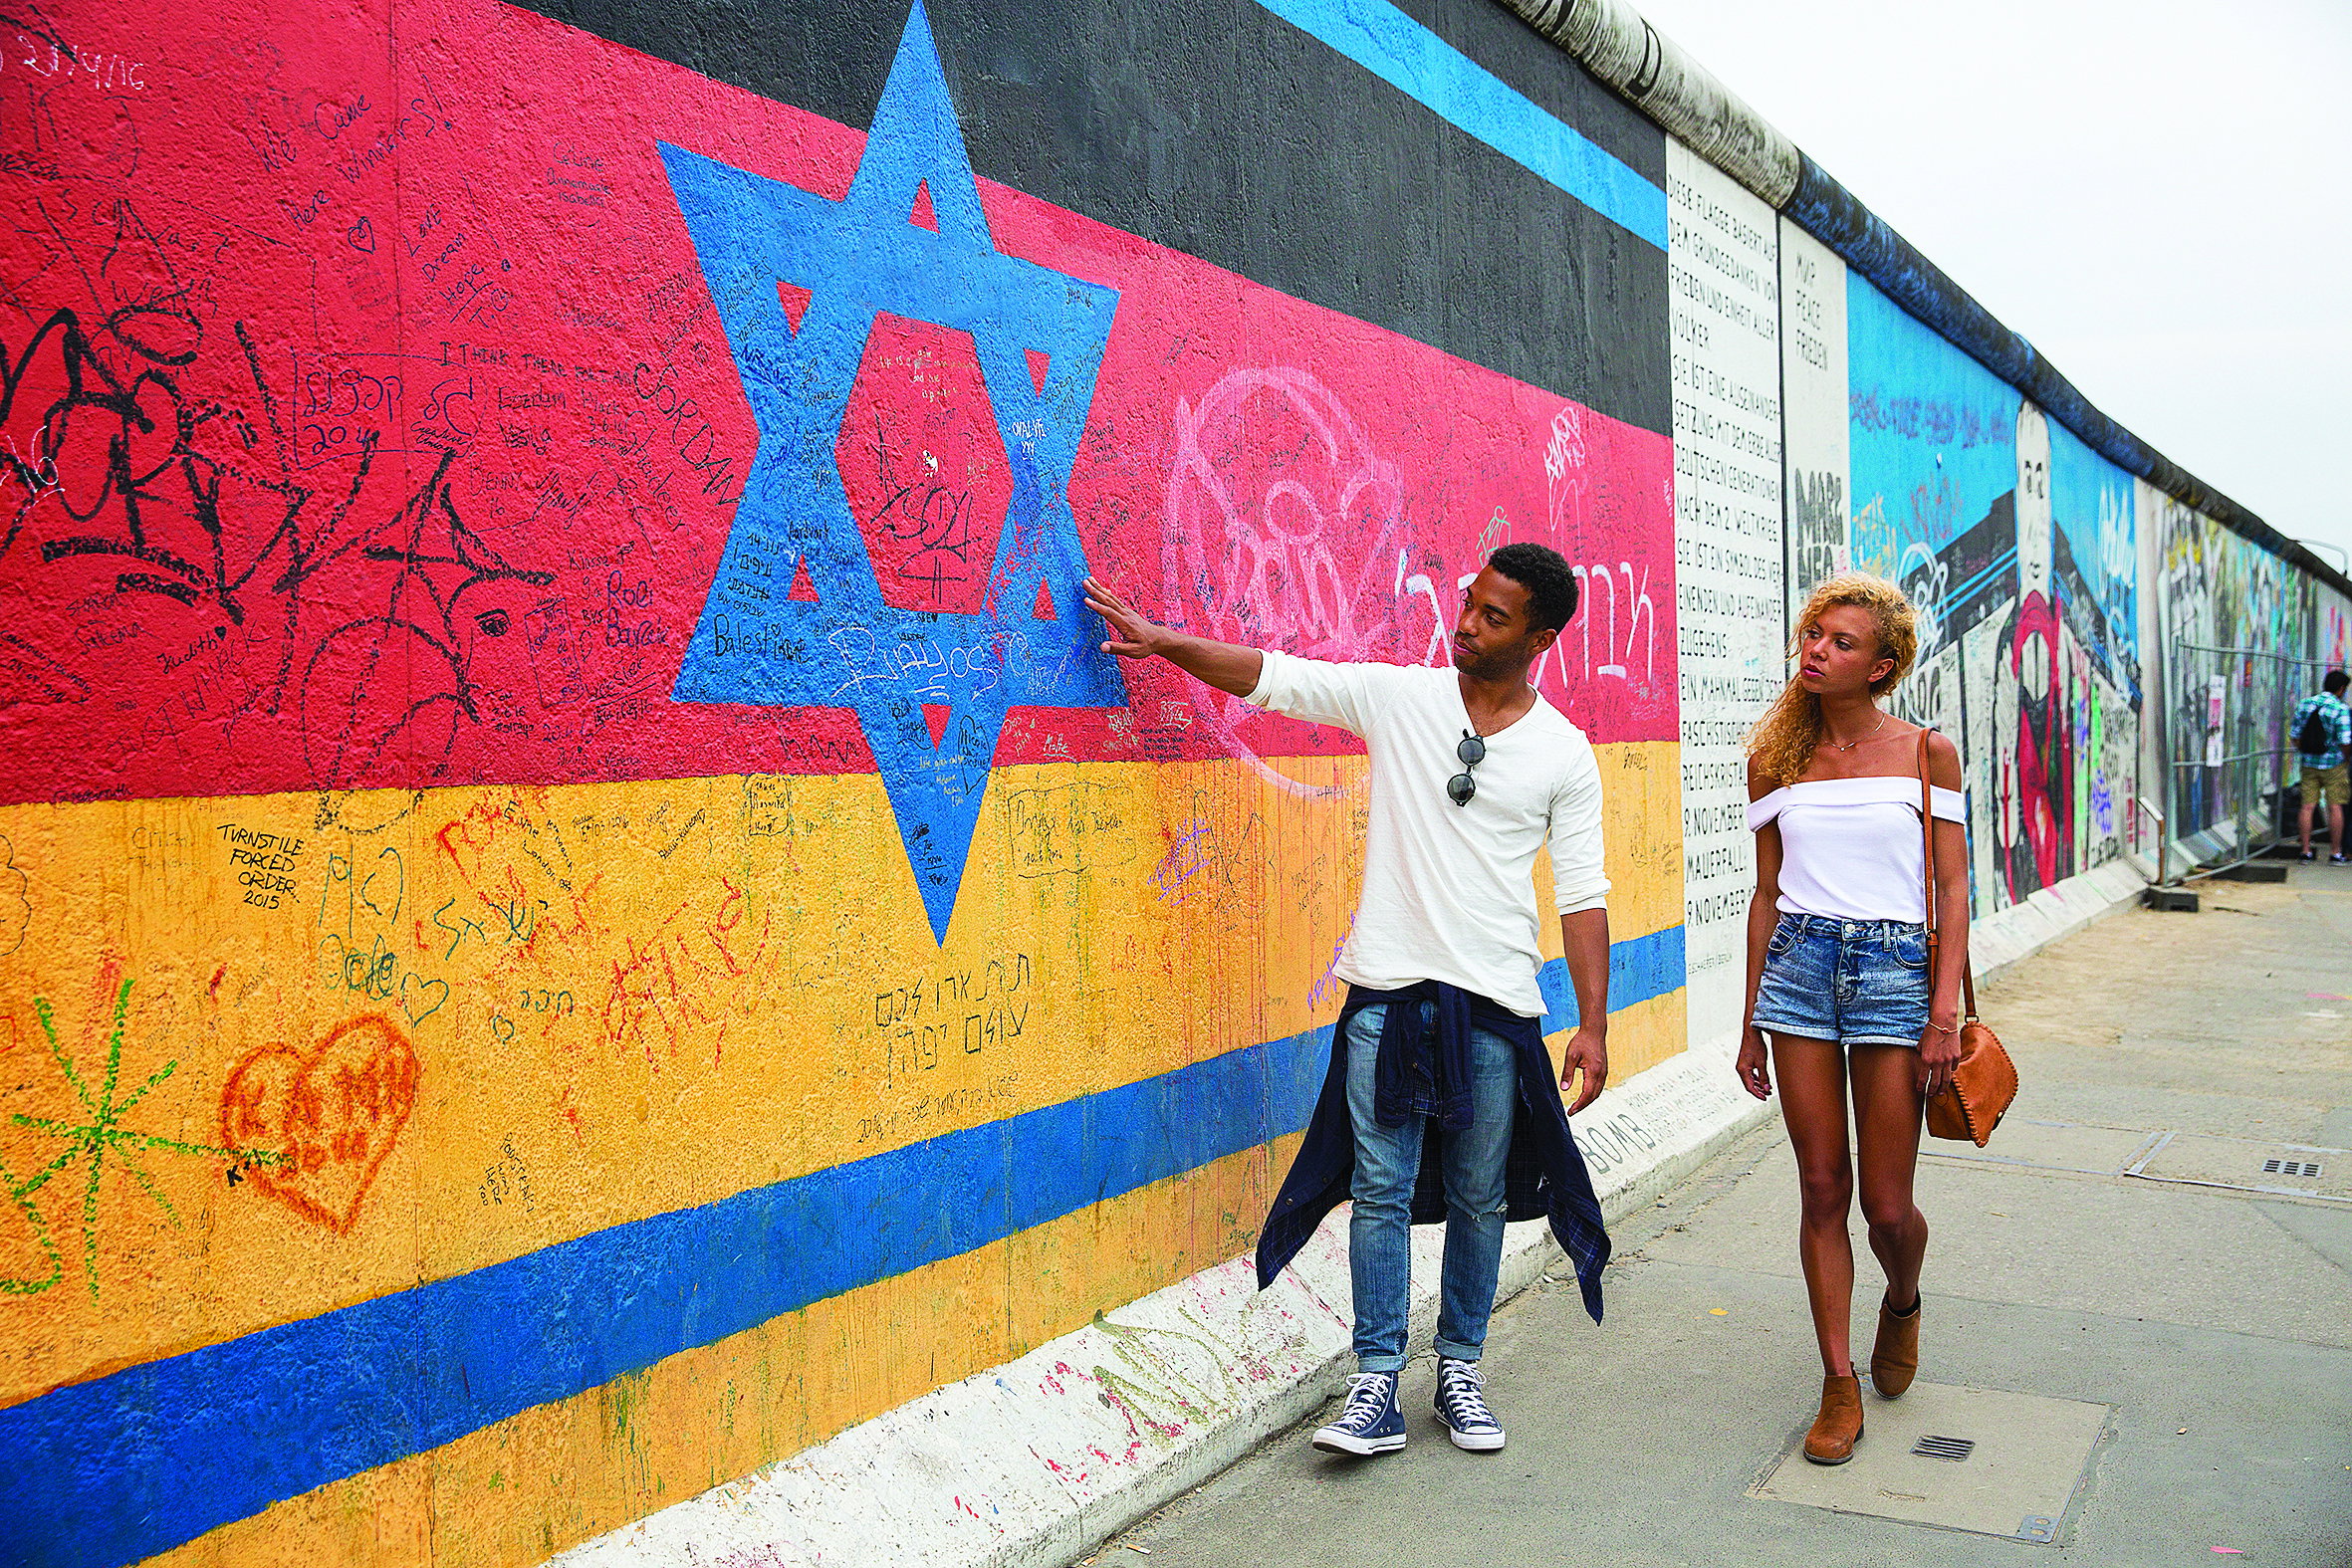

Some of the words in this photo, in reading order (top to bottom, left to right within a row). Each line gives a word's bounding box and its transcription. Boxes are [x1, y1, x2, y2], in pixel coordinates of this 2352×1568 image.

[247, 115, 297, 172] We
[314, 94, 371, 140] Came
[276, 189, 331, 232] Here
[1668, 173, 1693, 210] DIESE
[1697, 193, 1730, 234] FLAGGE
[1669, 217, 1690, 255] DEM
[1670, 263, 1706, 306] FRIEDEN
[1673, 353, 1688, 386] SIE
[1691, 360, 1705, 390] IST
[1675, 398, 1714, 439] SETZUNG
[1675, 443, 1727, 486] DEUTSCHEN
[1676, 491, 1701, 523] NACH
[1705, 499, 1723, 529] DEM
[1677, 538, 1691, 566] SIE
[1695, 541, 1708, 569] IST
[157, 631, 219, 674] Judith
[1680, 626, 1728, 659] ZUGEHENS
[1681, 673, 1697, 702] EIN
[1701, 674, 1741, 702] MAHNMAL
[1694, 802, 1745, 837] NOVEMBER
[217, 823, 304, 856] TURNSTILE
[230, 848, 295, 872] FORCED
[243, 890, 280, 909] 2015
[1696, 888, 1747, 927] NOVEMBER
